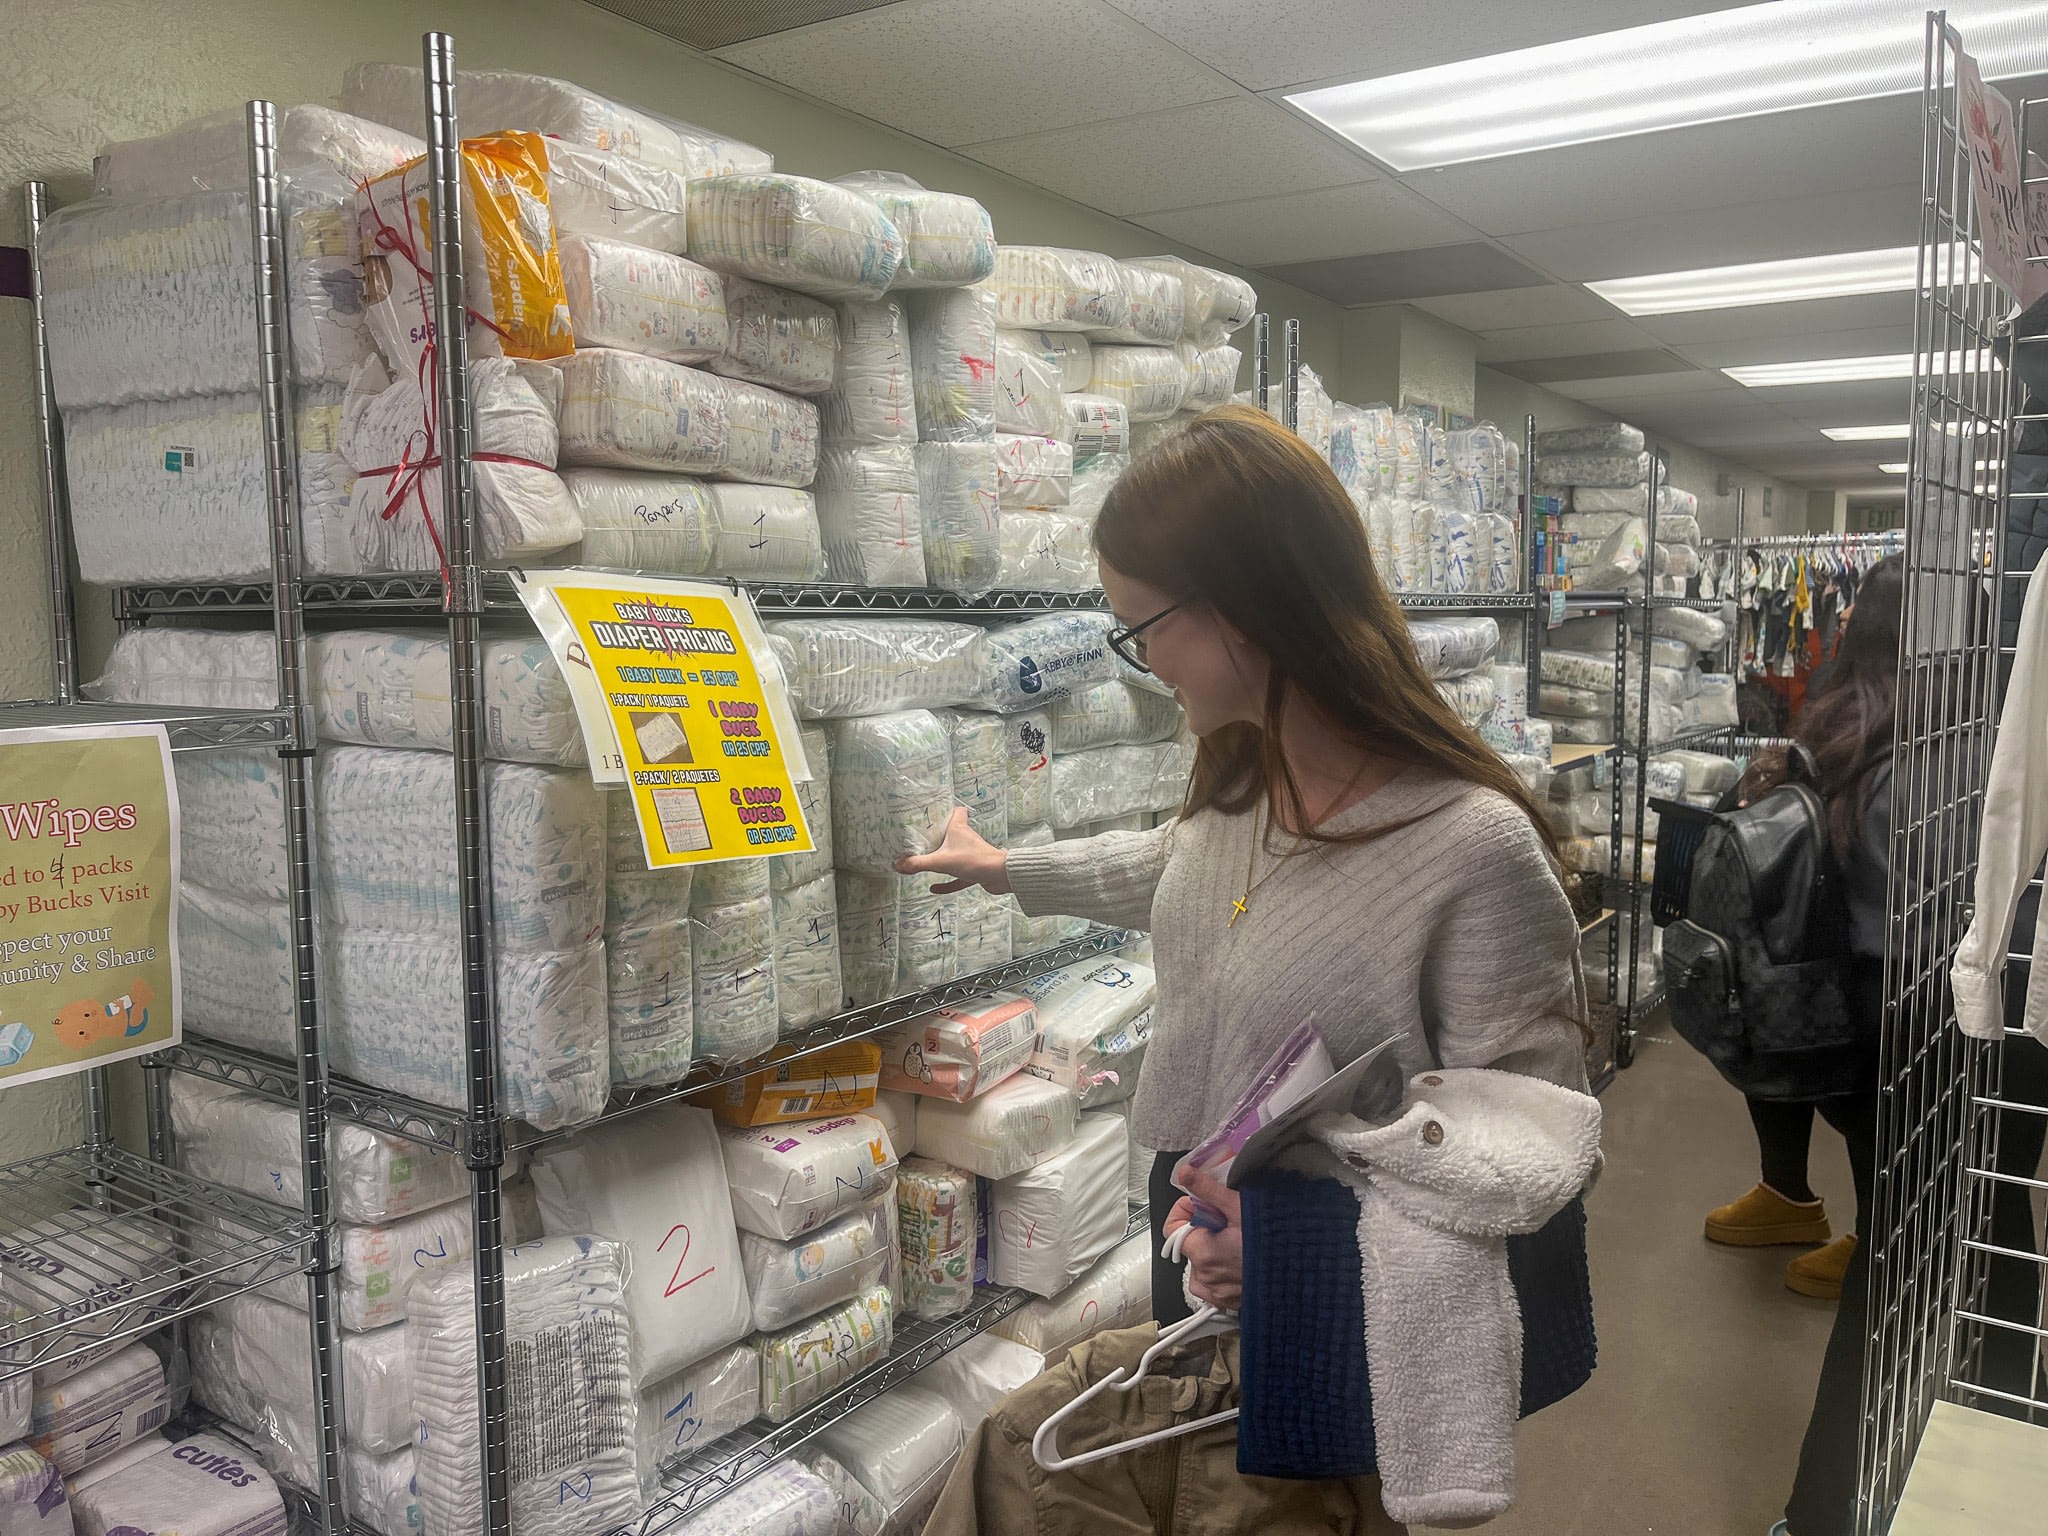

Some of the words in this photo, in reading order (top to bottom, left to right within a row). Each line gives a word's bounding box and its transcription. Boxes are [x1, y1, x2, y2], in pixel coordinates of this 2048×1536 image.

[613, 602, 651, 621] BABY
[651, 606, 694, 625] BUCKS
[590, 621, 666, 650] DIAPER
[664, 627, 736, 654] PRICING
[1075, 648, 1103, 663] FINN
[617, 667, 625, 682] 1
[625, 667, 654, 683] BABY
[655, 668, 686, 684] BUCK
[700, 670, 716, 686] 25
[708, 700, 718, 717] 1
[719, 701, 758, 718] BABY
[720, 720, 761, 737] BUCK
[721, 741, 736, 756] OR
[730, 788, 742, 805] 2
[743, 787, 781, 805] BABY
[0, 798, 137, 848] Wipes
[737, 805, 786, 824] BUCKS
[747, 828, 762, 845] OR
[761, 827, 774, 843] 50
[23, 868, 45, 884] to
[72, 855, 133, 885] packs
[27, 889, 93, 914] Bucks
[99, 882, 150, 904] Visit
[0, 932, 52, 962] pect
[57, 926, 113, 954] your
[0, 959, 64, 988] unity
[71, 954, 90, 974] &
[96, 946, 156, 970] Share
[807, 1117, 856, 1136] diapers
[657, 1224, 715, 1298] 2
[173, 1445, 257, 1487] cuties
